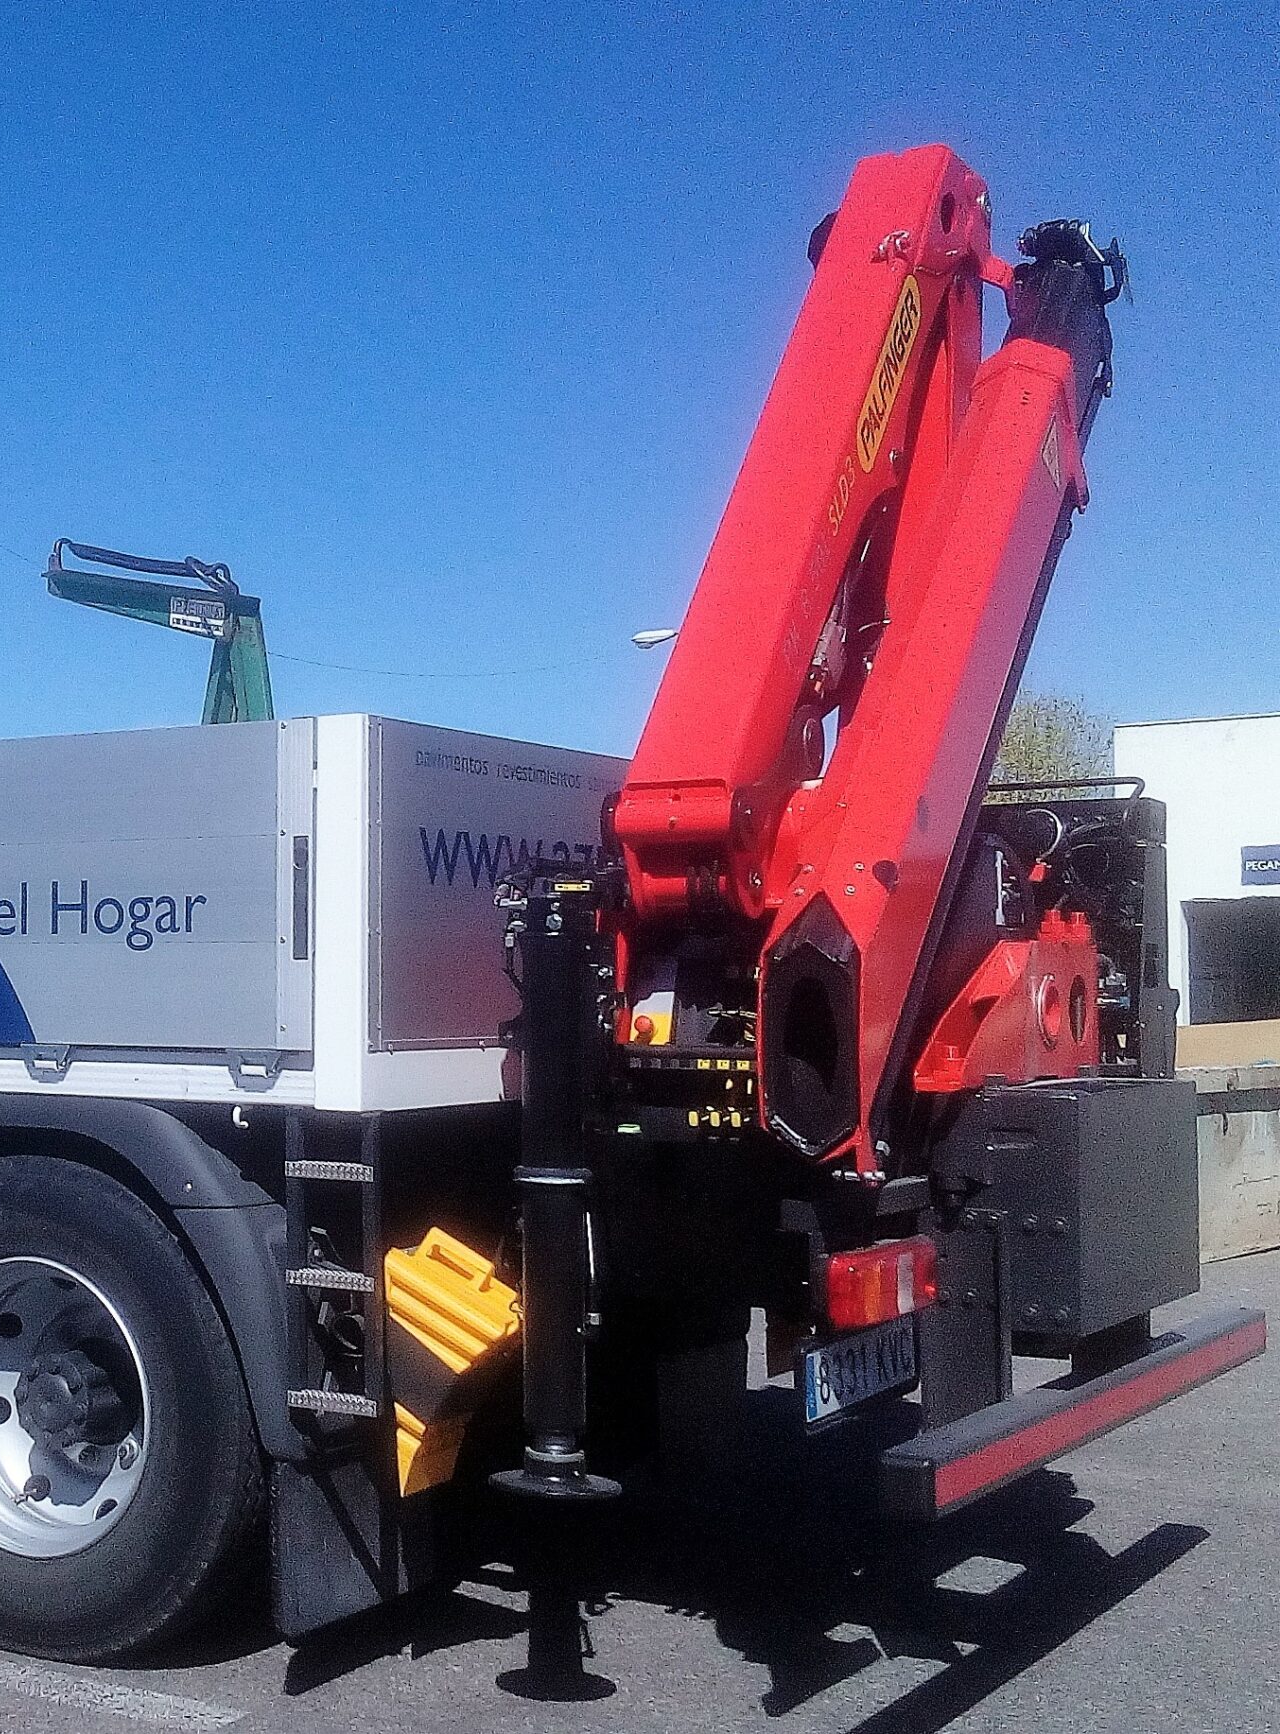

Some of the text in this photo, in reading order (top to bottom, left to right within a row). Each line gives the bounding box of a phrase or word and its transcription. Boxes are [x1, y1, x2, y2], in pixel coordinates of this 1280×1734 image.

[861, 288, 918, 461] PALFINGER
[415, 749, 489, 776] pavimentos
[496, 762, 582, 789] revestimientos
[51, 880, 208, 951] Hogar
